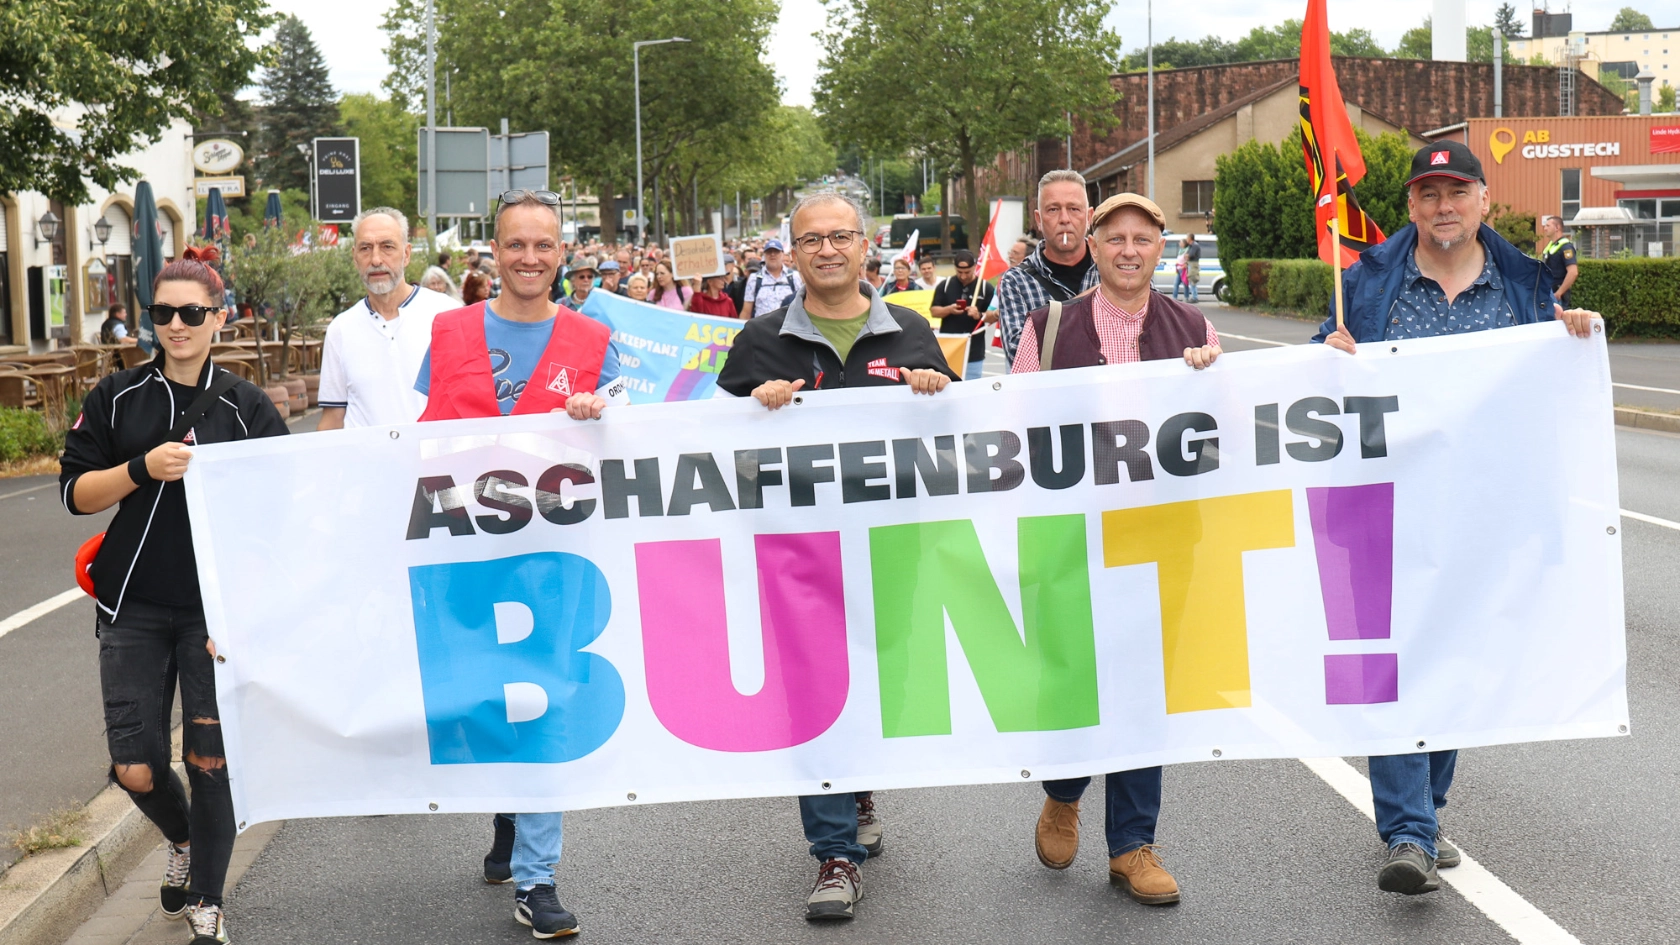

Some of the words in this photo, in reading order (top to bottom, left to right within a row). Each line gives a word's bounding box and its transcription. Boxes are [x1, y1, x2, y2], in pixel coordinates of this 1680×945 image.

[1523, 130, 1550, 143] AB
[1652, 128, 1667, 136] Linde
[1522, 142, 1620, 159] GUSSTECH
[677, 255, 718, 271] erhalten
[612, 329, 679, 358] AKZEPTANZ
[867, 358, 887, 367] TEAM
[406, 412, 1219, 540] ASCHAFFENBURG
[1255, 396, 1399, 466] IST
[408, 482, 1398, 765] BUNT!
